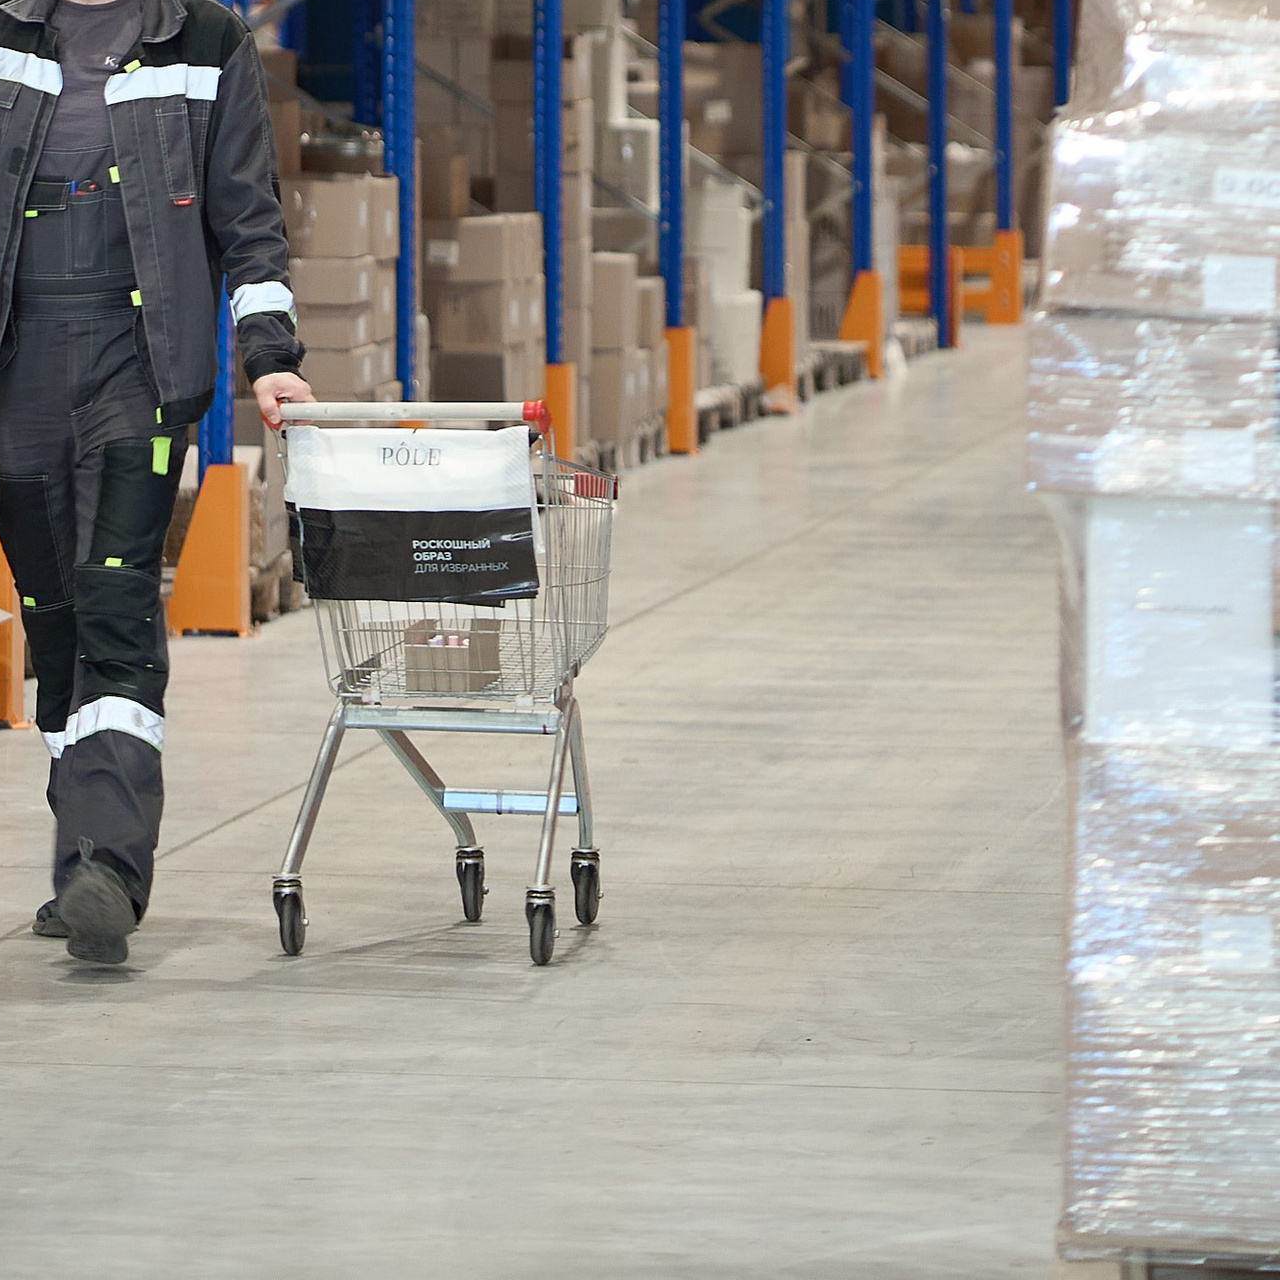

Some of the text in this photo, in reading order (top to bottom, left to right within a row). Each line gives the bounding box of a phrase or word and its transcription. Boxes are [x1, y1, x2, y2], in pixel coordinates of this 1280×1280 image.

[412, 538, 491, 550] РОСКОШНЫЙ
[413, 551, 452, 561] ОБРАЗ
[414, 561, 509, 574] ДЛЯ ИЗБРАННЫХ
